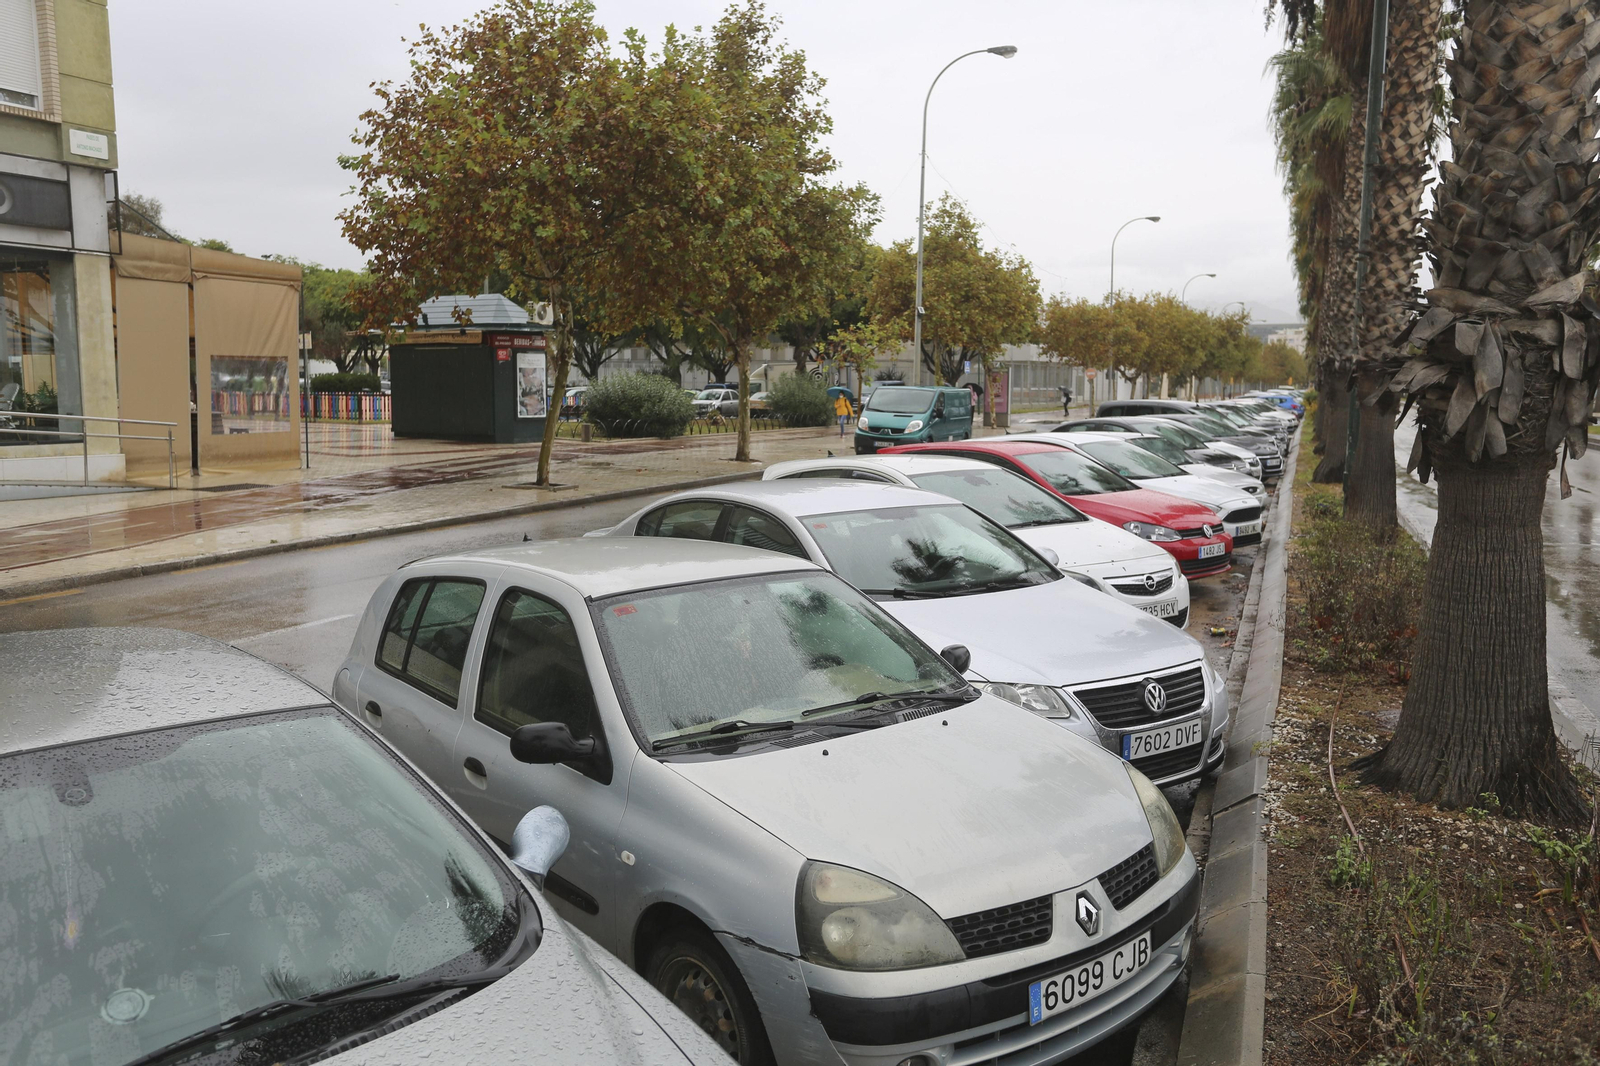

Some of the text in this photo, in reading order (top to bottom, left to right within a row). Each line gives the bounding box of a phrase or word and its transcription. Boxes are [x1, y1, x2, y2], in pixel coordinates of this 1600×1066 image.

[1140, 605, 1158, 617] 35
[1133, 731, 1171, 756] 7602
[1175, 723, 1199, 747] DVF
[1044, 960, 1104, 1011] 6099
[1112, 937, 1149, 980] CJB
